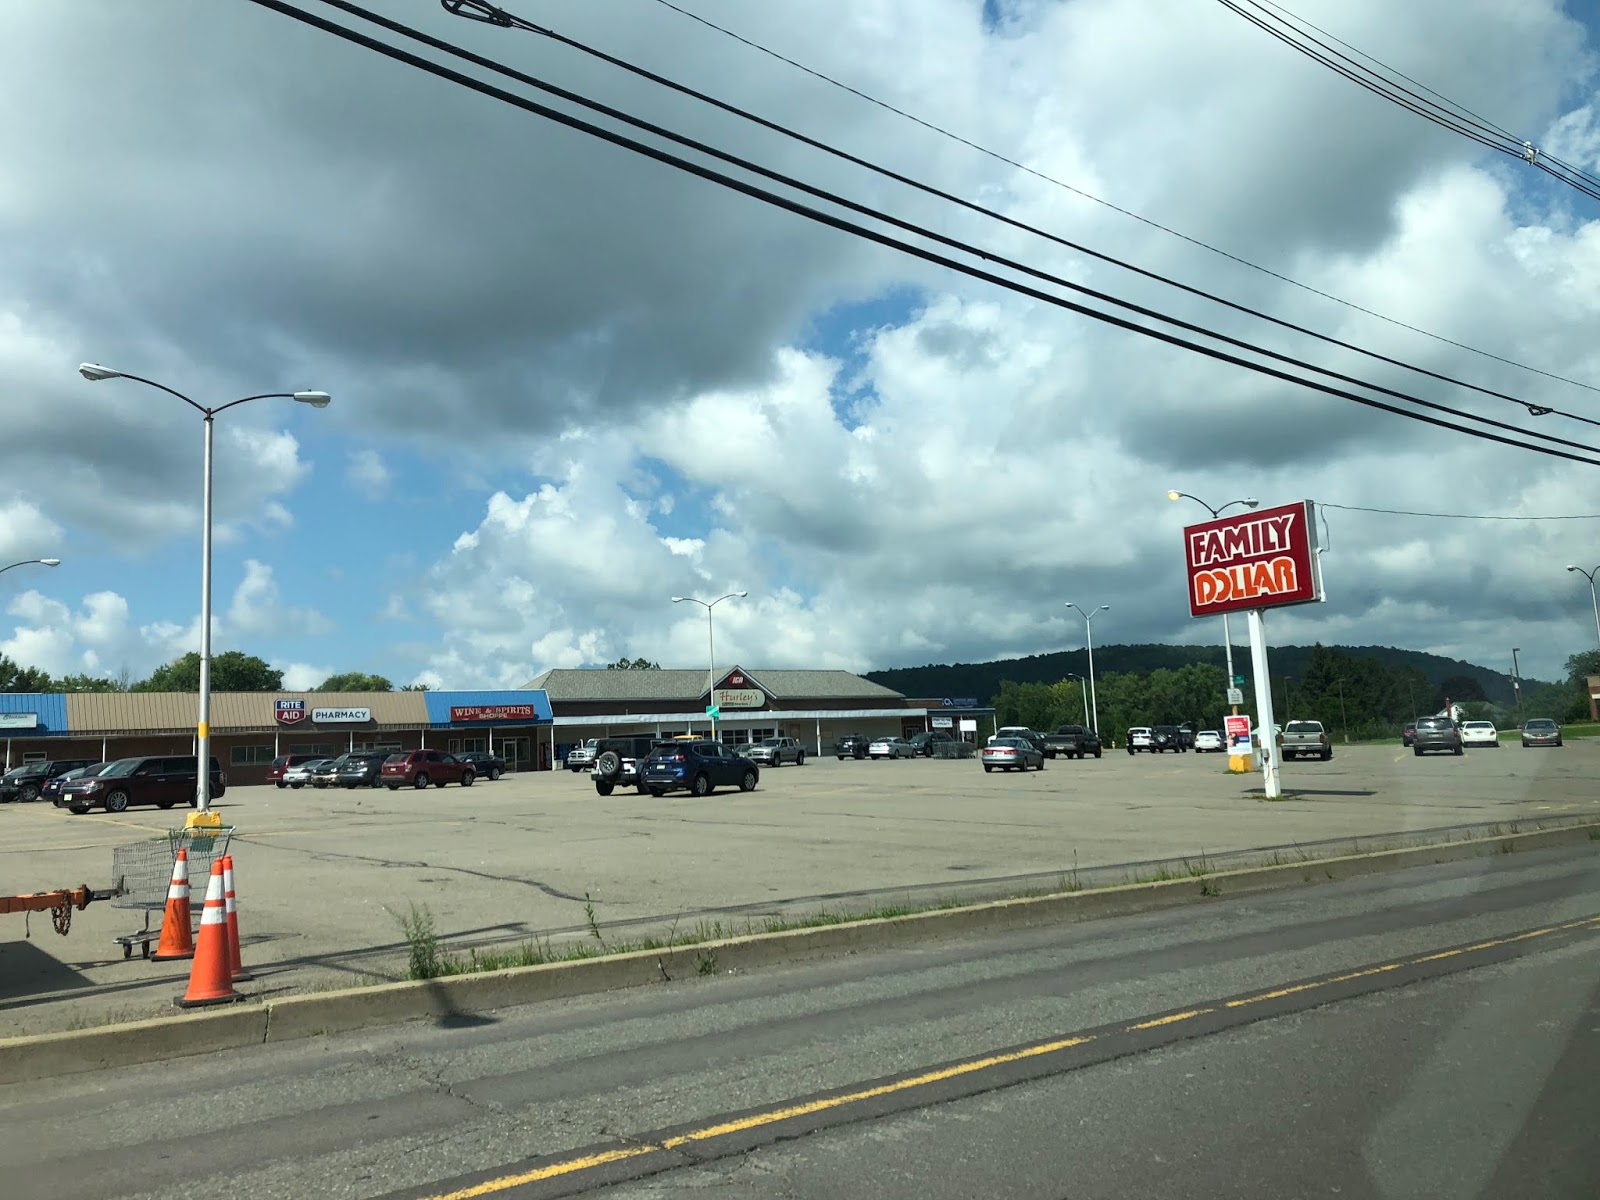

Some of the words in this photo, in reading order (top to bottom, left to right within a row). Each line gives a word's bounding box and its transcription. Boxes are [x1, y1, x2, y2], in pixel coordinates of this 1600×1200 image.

[1190, 513, 1296, 567] FAMILY
[1194, 556, 1298, 606] DOLLAR
[732, 676, 744, 684] IGA
[280, 701, 301, 709] RITE
[282, 711, 300, 720] AID
[315, 711, 367, 719] PHARMACY
[454, 707, 482, 717] WINE
[495, 706, 531, 715] SPIRITS
